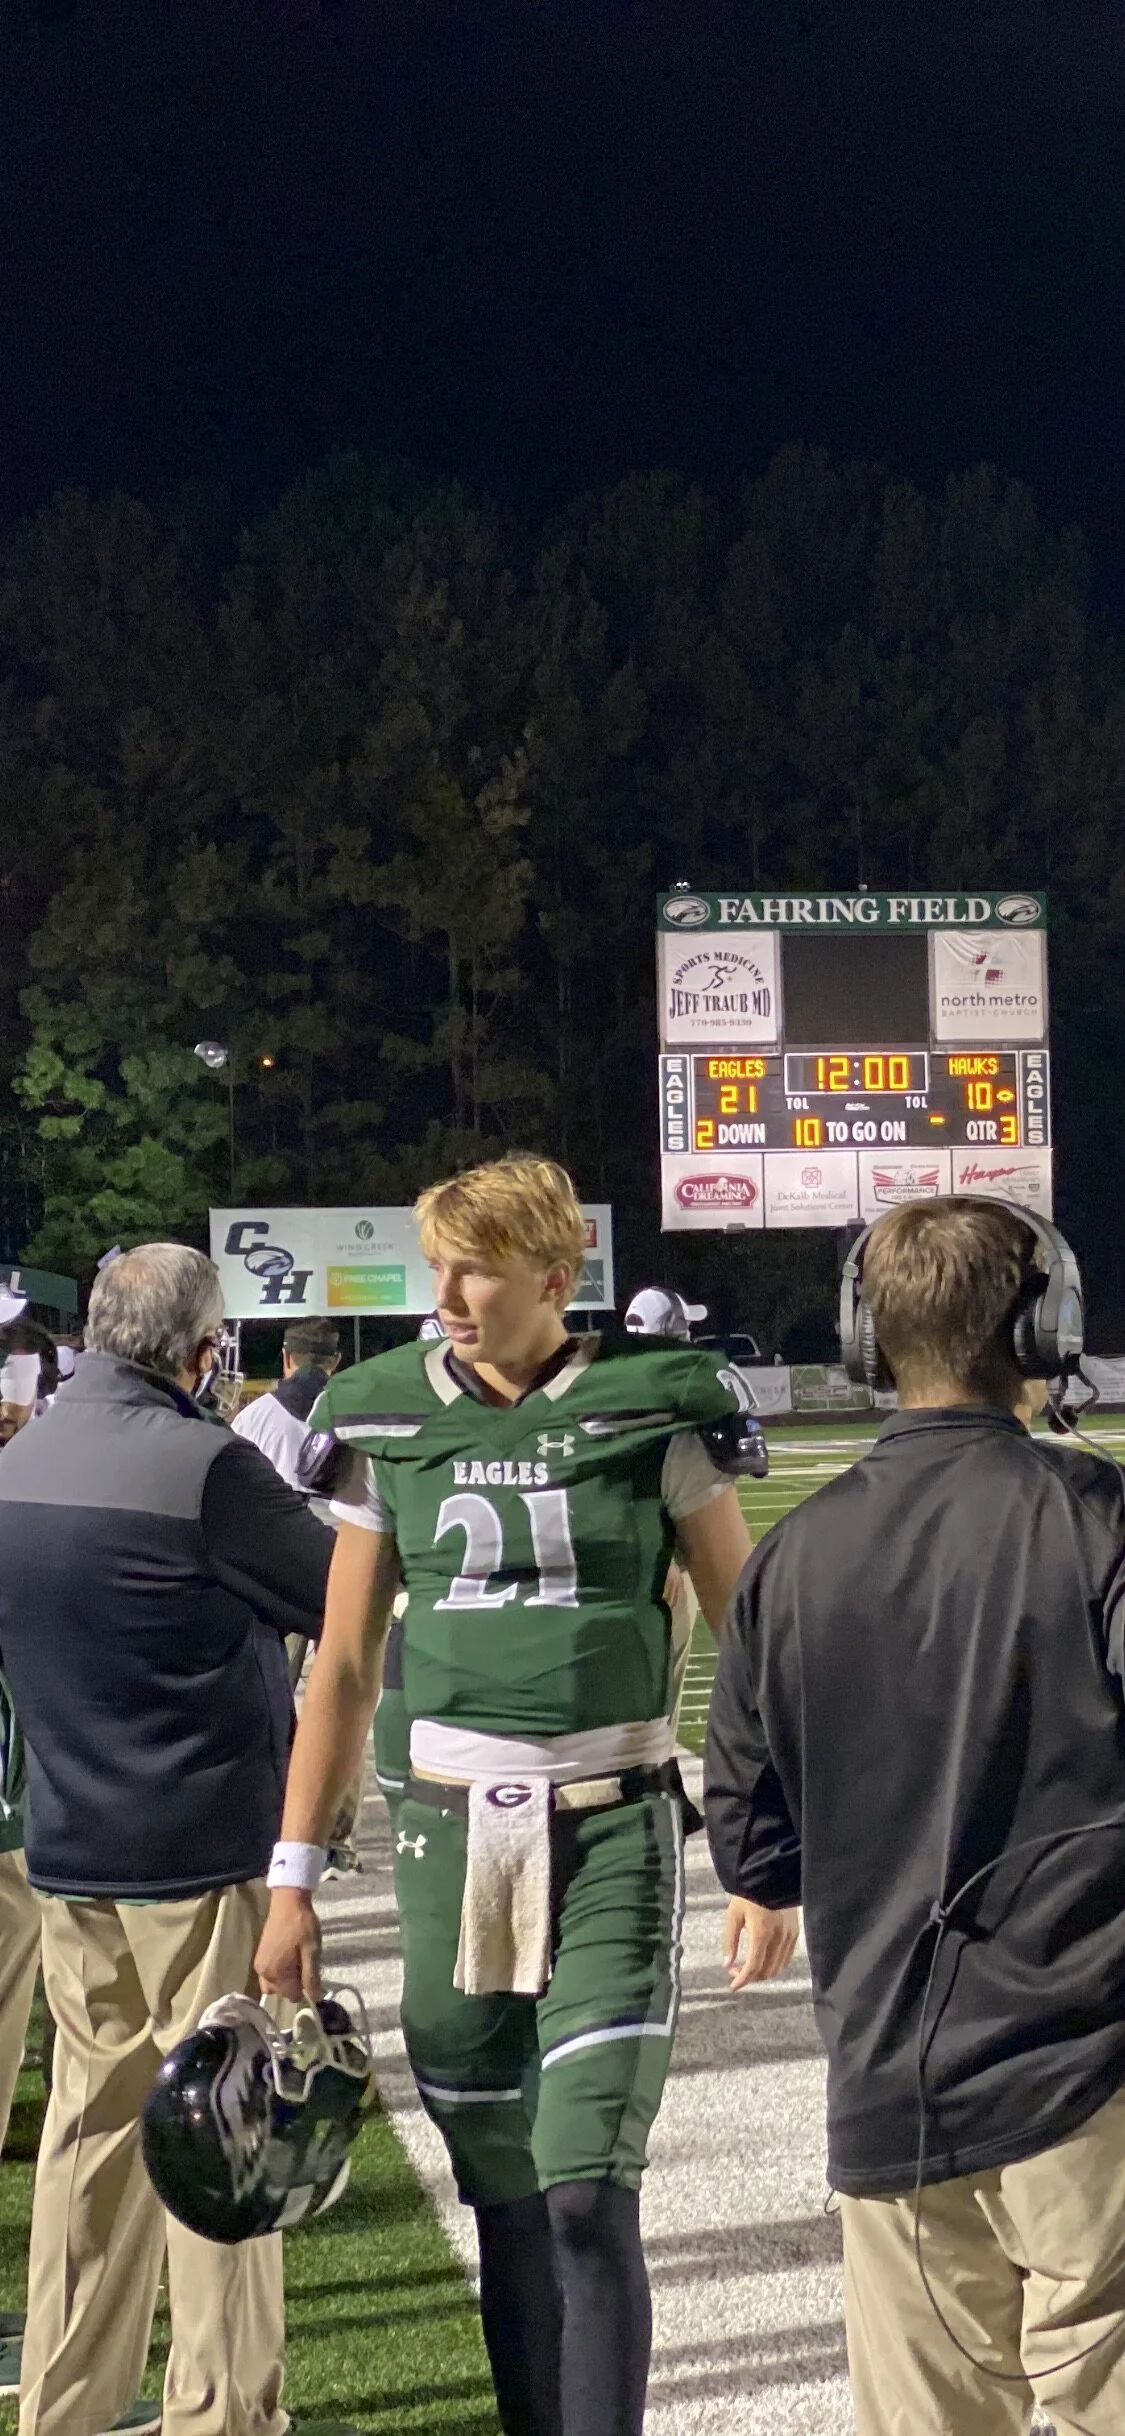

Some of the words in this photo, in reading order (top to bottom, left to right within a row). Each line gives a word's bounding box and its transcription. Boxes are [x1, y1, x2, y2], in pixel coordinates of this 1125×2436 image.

[718, 898, 880, 923] FAHRING
[886, 897, 991, 922] FIELD
[673, 952, 710, 985] SPORTS
[713, 951, 765, 985] MEDICINE
[669, 988, 700, 1019] JEFF
[703, 993, 748, 1013] TRAUB
[752, 987, 771, 1018] MD
[941, 992, 985, 1007] north
[989, 993, 1038, 1006] metro
[708, 1059, 765, 1079] EAGLES
[817, 1056, 910, 1091] 12:00
[949, 1057, 999, 1076] HAWKS
[666, 1058, 685, 1150] EAGLES
[720, 1085, 758, 1113] 21
[786, 1097, 809, 1110] TOL
[905, 1096, 928, 1109] TOL
[967, 1082, 993, 1110] 10
[1026, 1054, 1044, 1145] EAGLES
[697, 1119, 715, 1147] 2
[718, 1123, 766, 1144] DOWN
[795, 1118, 821, 1146] 10
[826, 1121, 848, 1142] TO
[852, 1121, 876, 1142] GO
[880, 1120, 906, 1141] ON
[966, 1120, 998, 1141] QTR
[1000, 1116, 1017, 1144] 3
[681, 1183, 750, 1198] CALIFRNIA
[693, 1191, 746, 1201] DREAMING
[453, 1461, 549, 1485] EAGLES
[432, 1489, 580, 1611] 21
[485, 1784, 532, 1808] G
